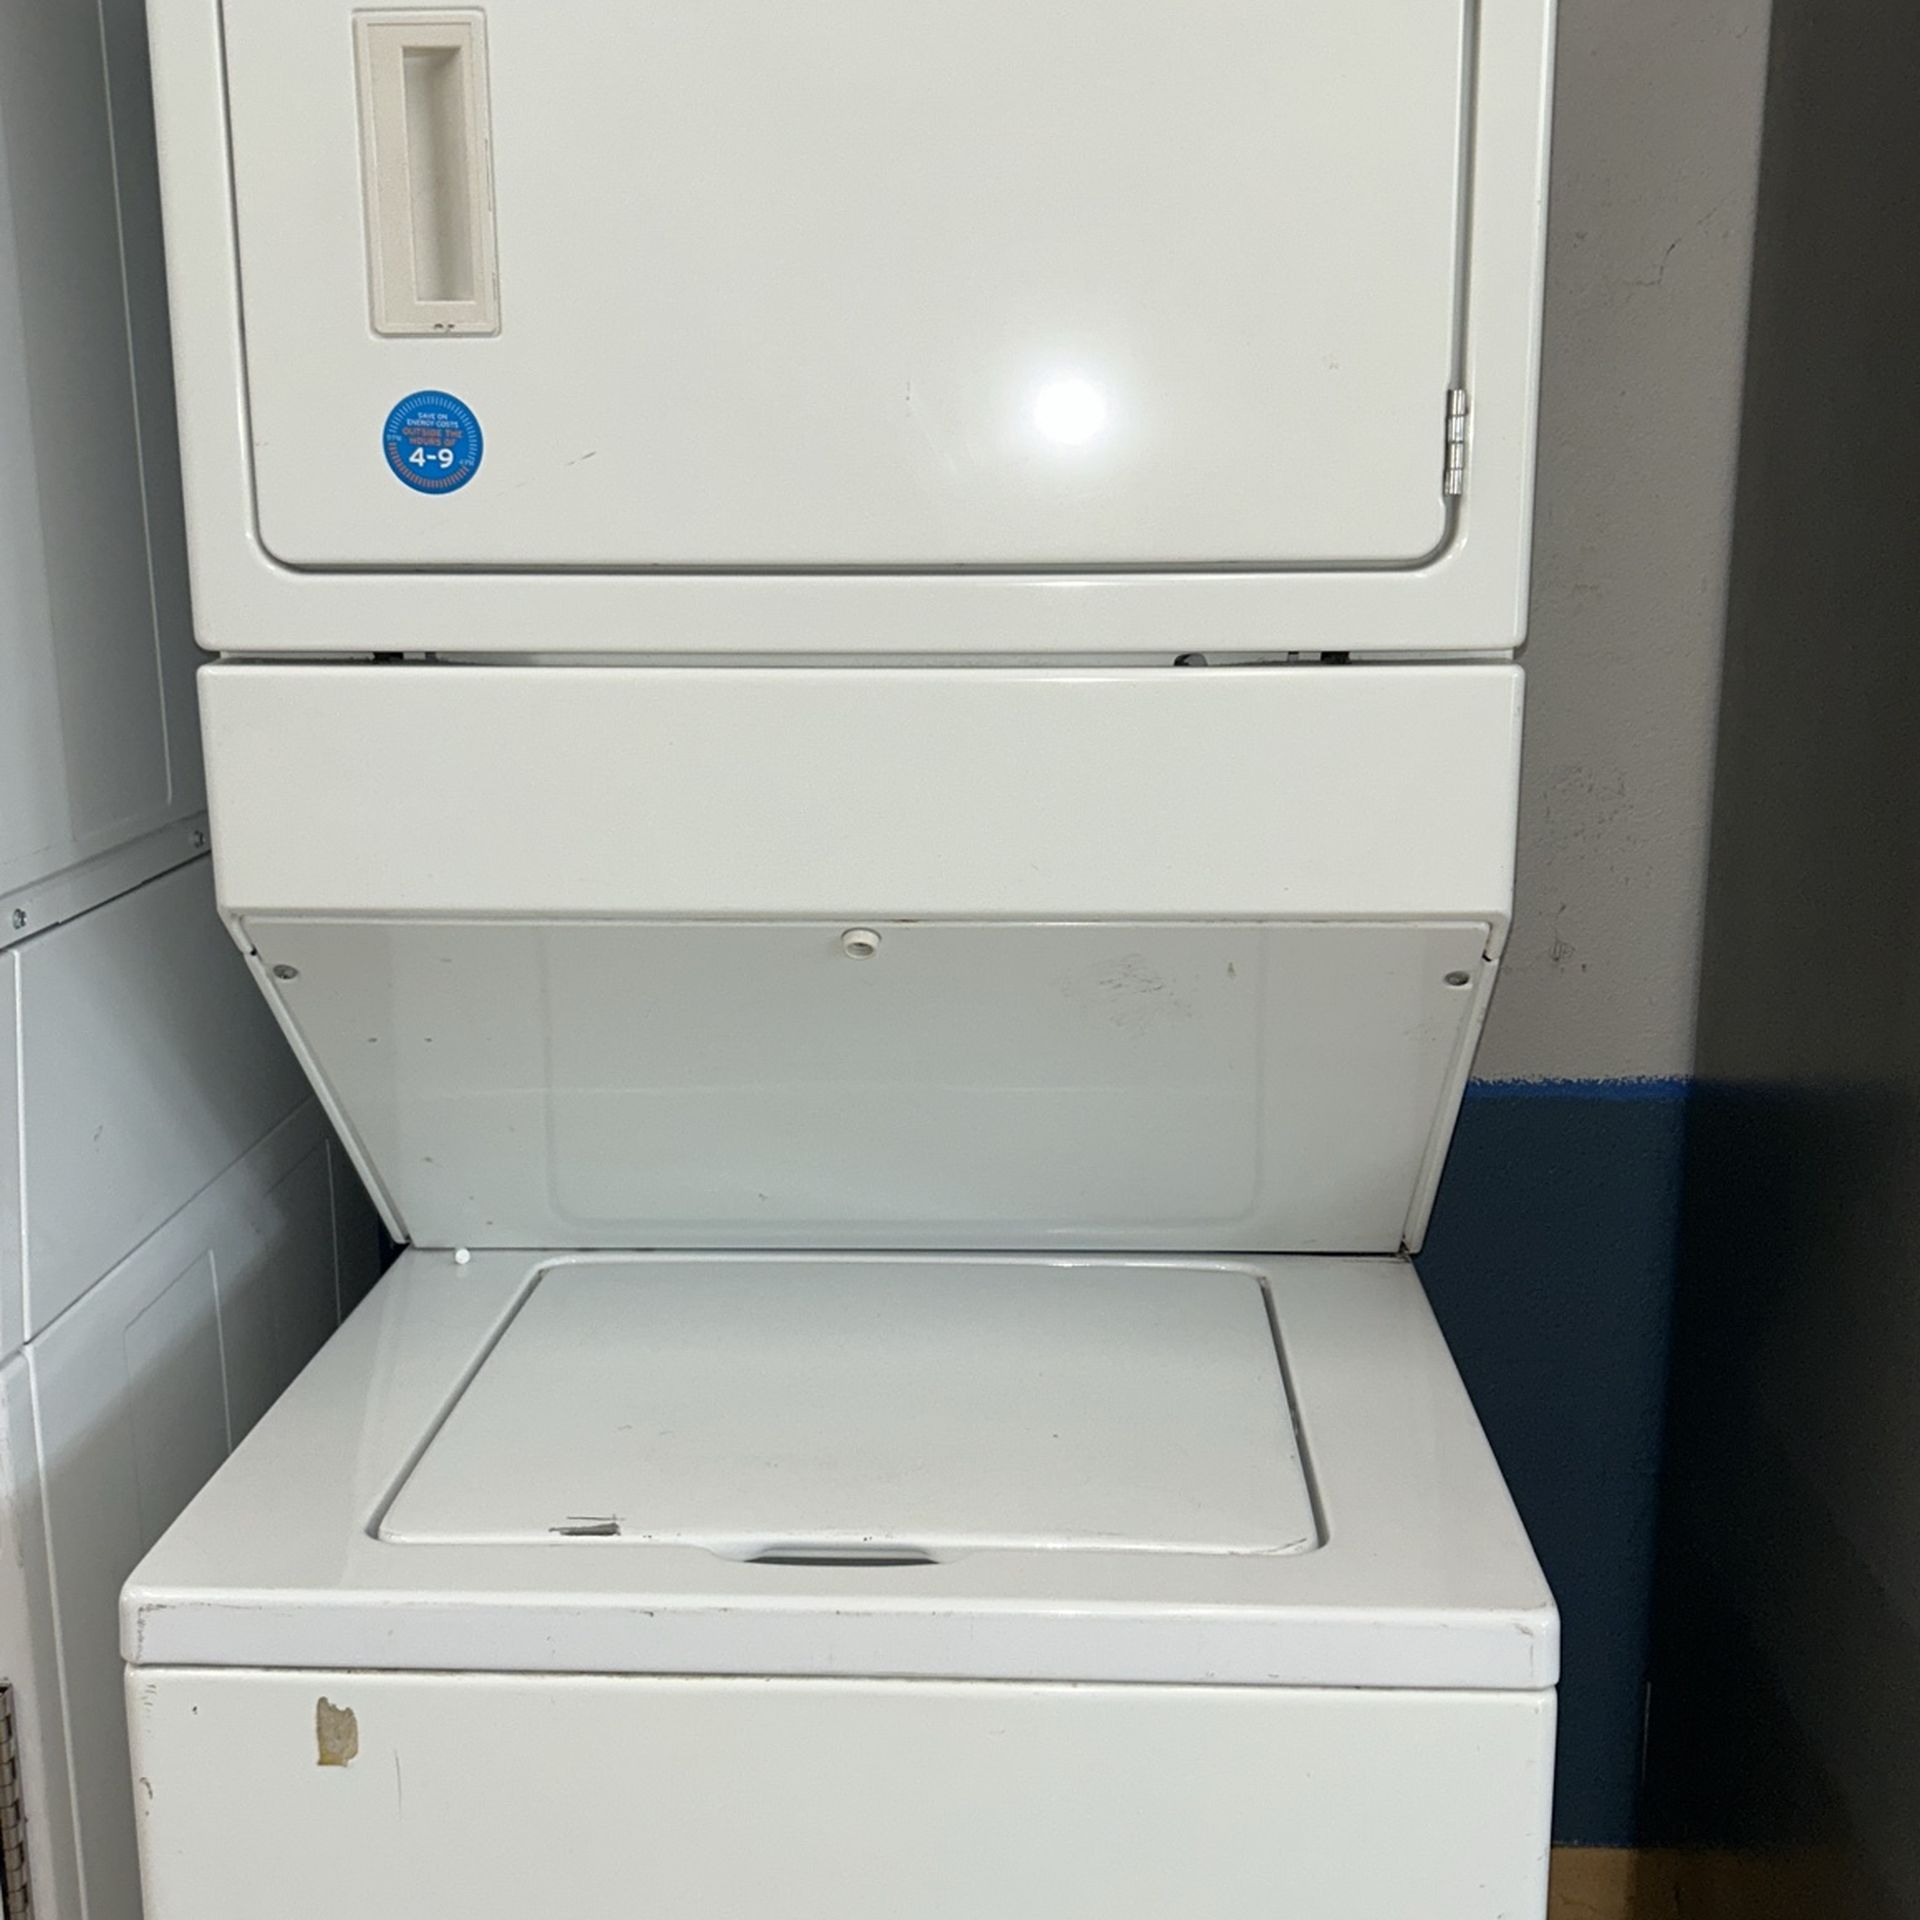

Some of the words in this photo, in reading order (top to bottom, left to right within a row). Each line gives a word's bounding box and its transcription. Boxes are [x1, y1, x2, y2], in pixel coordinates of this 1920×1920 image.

[437, 413, 448, 421] ON
[436, 420, 459, 428] COSTS
[402, 427, 441, 437] OUTSIDE
[445, 428, 464, 438] THE
[409, 437, 441, 446] HOURS
[444, 438, 457, 446] OF
[409, 447, 454, 468] 4-9
